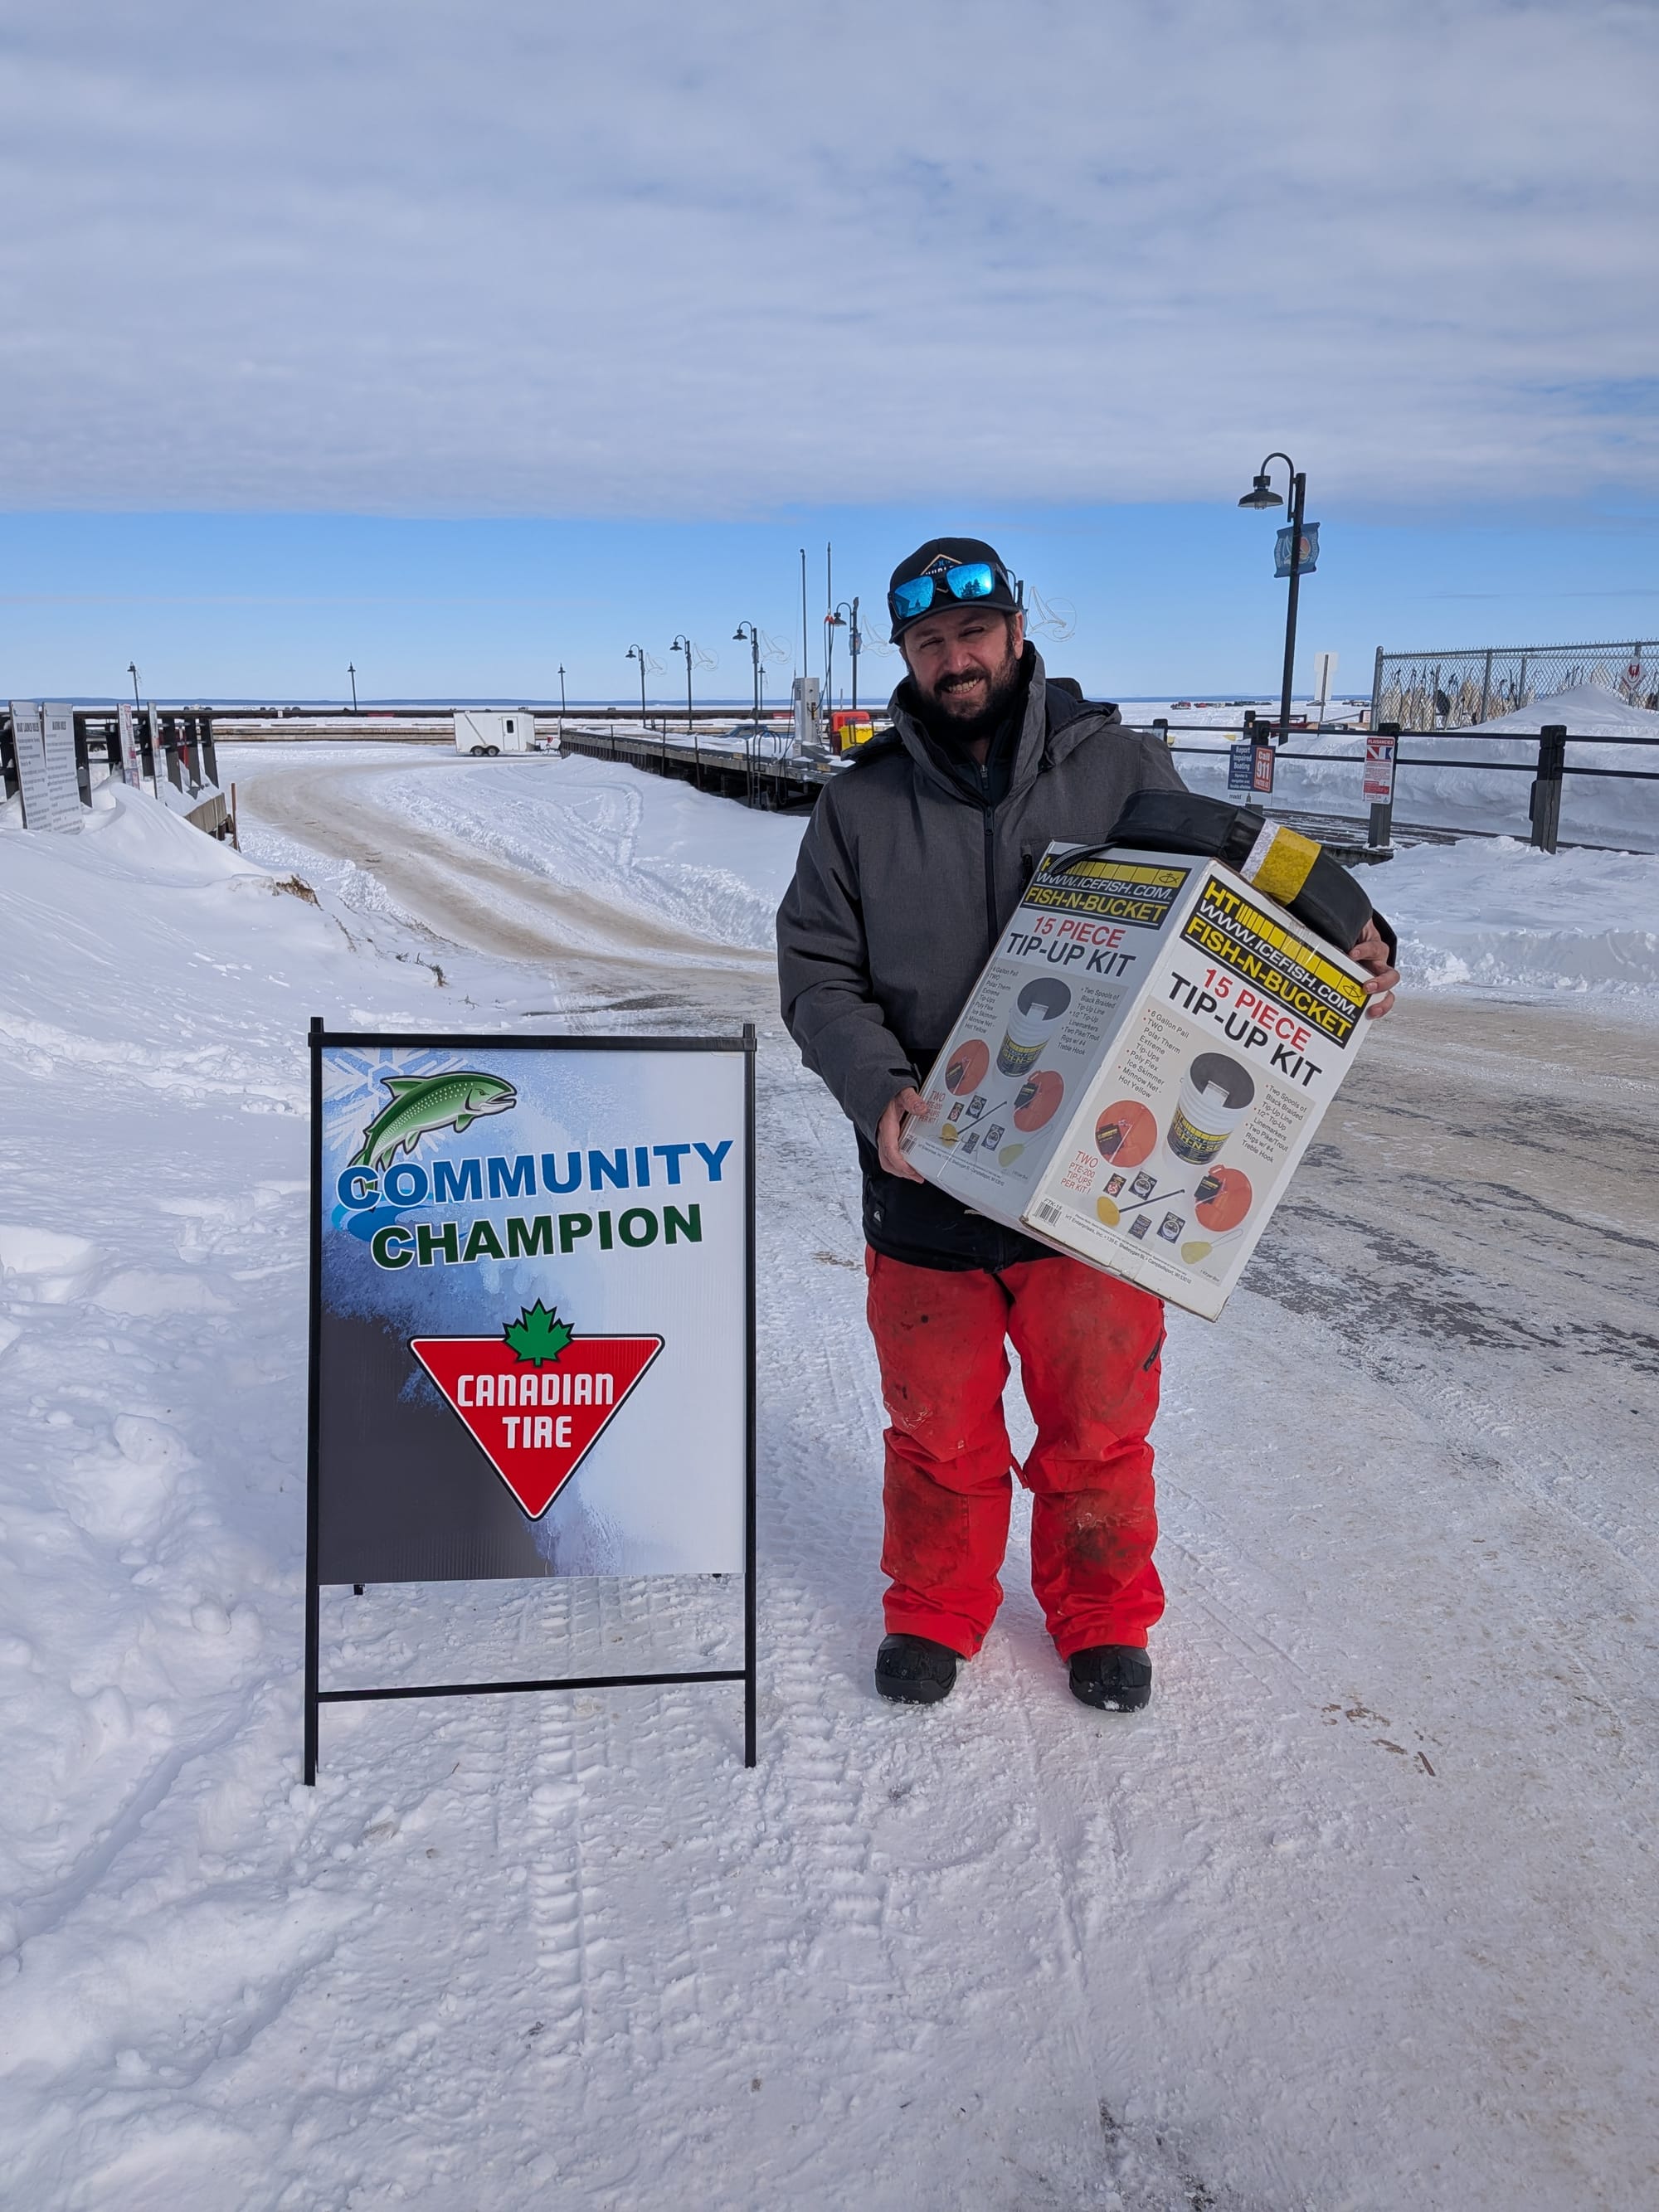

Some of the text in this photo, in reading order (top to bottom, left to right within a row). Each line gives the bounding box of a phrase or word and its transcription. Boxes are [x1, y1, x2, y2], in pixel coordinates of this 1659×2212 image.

[1233, 754, 1252, 762] Impaired
[1236, 746, 1250, 755] Report
[1258, 751, 1270, 761] Call
[1233, 762, 1250, 771] Boating
[1257, 761, 1270, 780] 911
[1036, 873, 1172, 899] WWW.ICEFISH.COM
[1204, 881, 1240, 913] HT
[1025, 887, 1168, 921] FISH-N-BUCKET
[1034, 916, 1126, 949] 15 PIECE
[1007, 932, 1136, 977] TIP-UP KIT
[1200, 899, 1355, 1015] WWW.ICEFISH.COM
[1187, 916, 1352, 1037] FISH-N-BUCKET
[1081, 995, 1117, 1009] Black Braided
[1094, 989, 1112, 999] Spools
[1077, 1003, 1093, 1014] Tip-Up
[1082, 1014, 1099, 1023] Tip-Up
[1204, 969, 1311, 1052] 15 PIECE
[1064, 1026, 1074, 1034] Two
[1148, 1018, 1163, 1032] TWO
[1156, 1014, 1176, 1030] Gallon
[1176, 1027, 1190, 1038] Pail
[1169, 972, 1322, 1087] TIP-UP KIT
[1072, 1047, 1085, 1055] Hook
[1136, 1043, 1160, 1062] Tip-Ups
[1140, 1035, 1165, 1055] Extreme
[1144, 1027, 1180, 1054] Polar Therm
[1126, 1059, 1165, 1086] Ice Skimmer
[1130, 1050, 1159, 1072] Poly Flex
[1118, 1075, 1151, 1098] Hot Yellow
[1122, 1067, 1147, 1085] Minnow
[1146, 1082, 1159, 1092] Net
[1266, 1093, 1303, 1121] Black Braided
[1269, 1085, 1280, 1096] Two
[1281, 1093, 1300, 1109] Spools
[1262, 1101, 1292, 1125] Tip-Up Line
[1269, 1116, 1287, 1130] Tip-Up
[1245, 1132, 1258, 1144] Rigs
[1249, 1123, 1288, 1152] Two Pike/Trout
[1253, 1117, 1287, 1141] Linemarkers
[1075, 1150, 1098, 1168] TWO
[1242, 1139, 1274, 1163] Treble Hook
[337, 1140, 733, 1210] COMMUNITY
[1067, 1170, 1092, 1187] TIP-UPS
[1068, 1162, 1095, 1179] PTE-200
[1060, 1178, 1075, 1189] PER
[371, 1203, 703, 1270] CHAMPION
[457, 1373, 614, 1407] CANADIAN
[502, 1416, 572, 1449] TIRE
